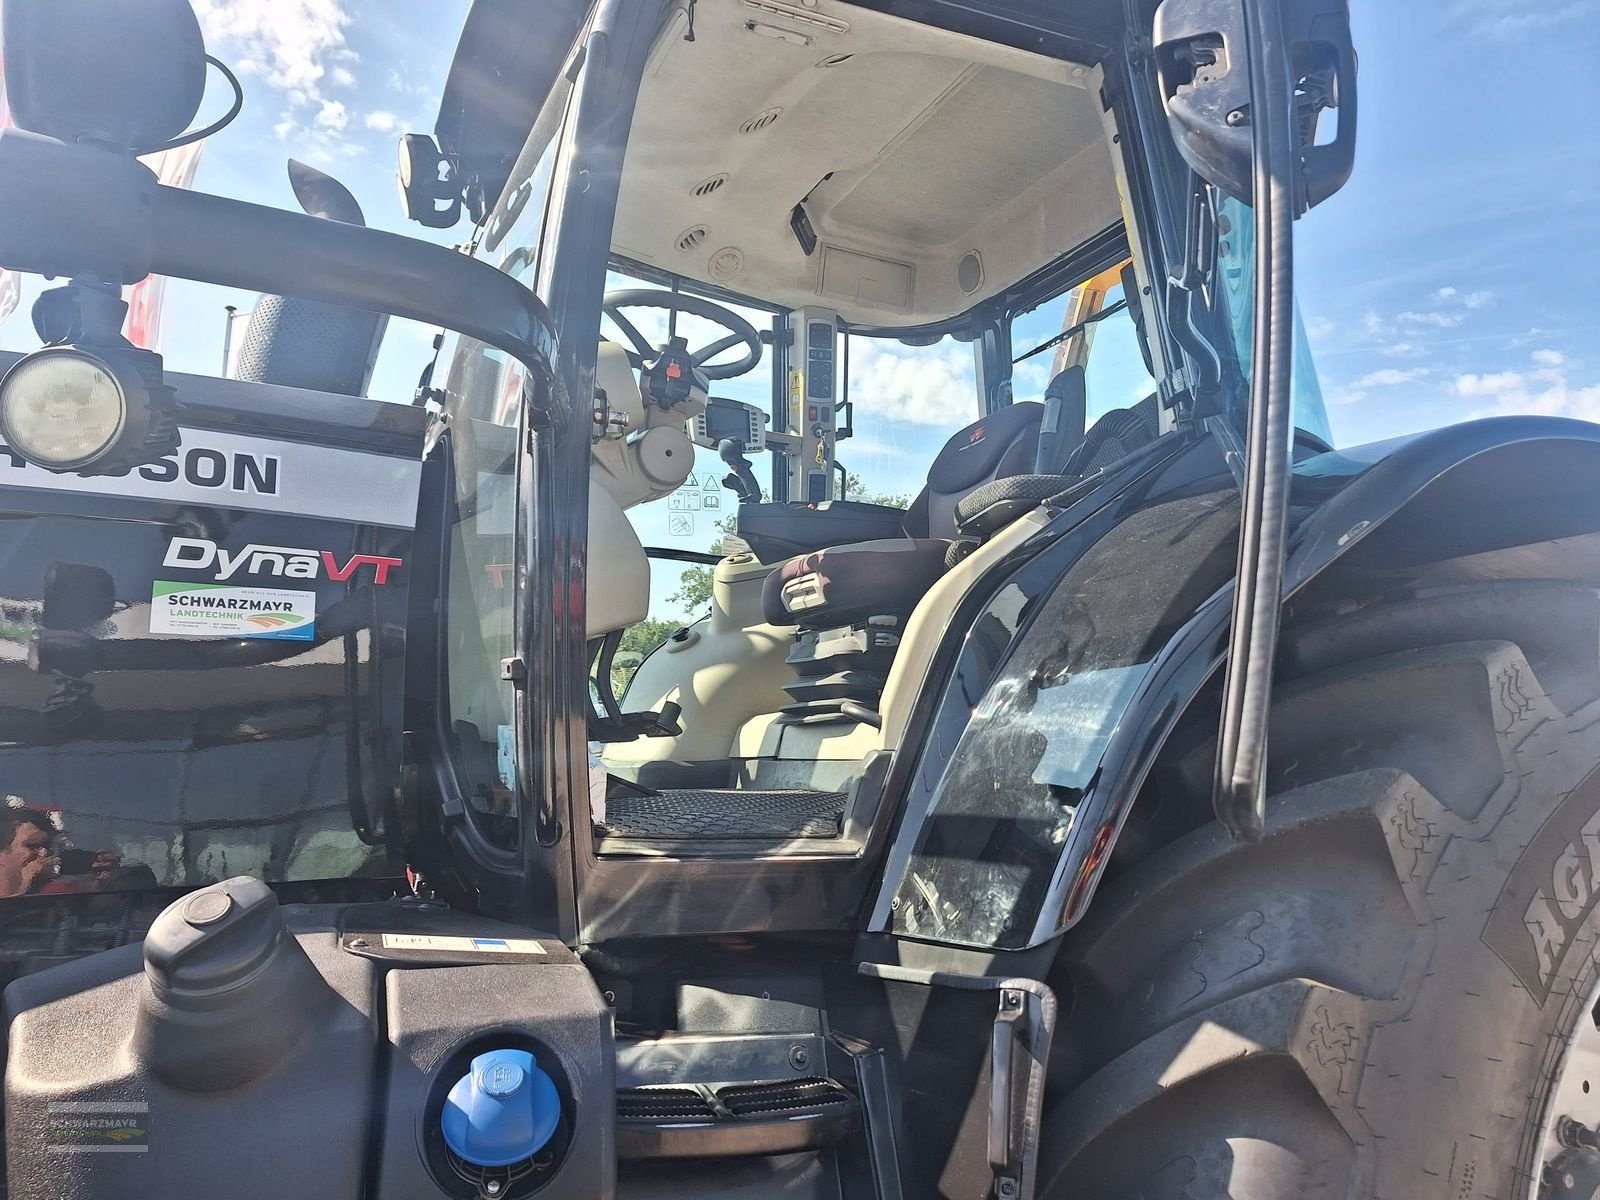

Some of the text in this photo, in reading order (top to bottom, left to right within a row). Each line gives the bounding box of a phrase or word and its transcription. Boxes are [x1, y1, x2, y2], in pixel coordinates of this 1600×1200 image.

[162, 536, 403, 585] DynaVT
[168, 594, 293, 612] SCHWARZMAYR
[169, 608, 244, 620] LANDTECHNIK
